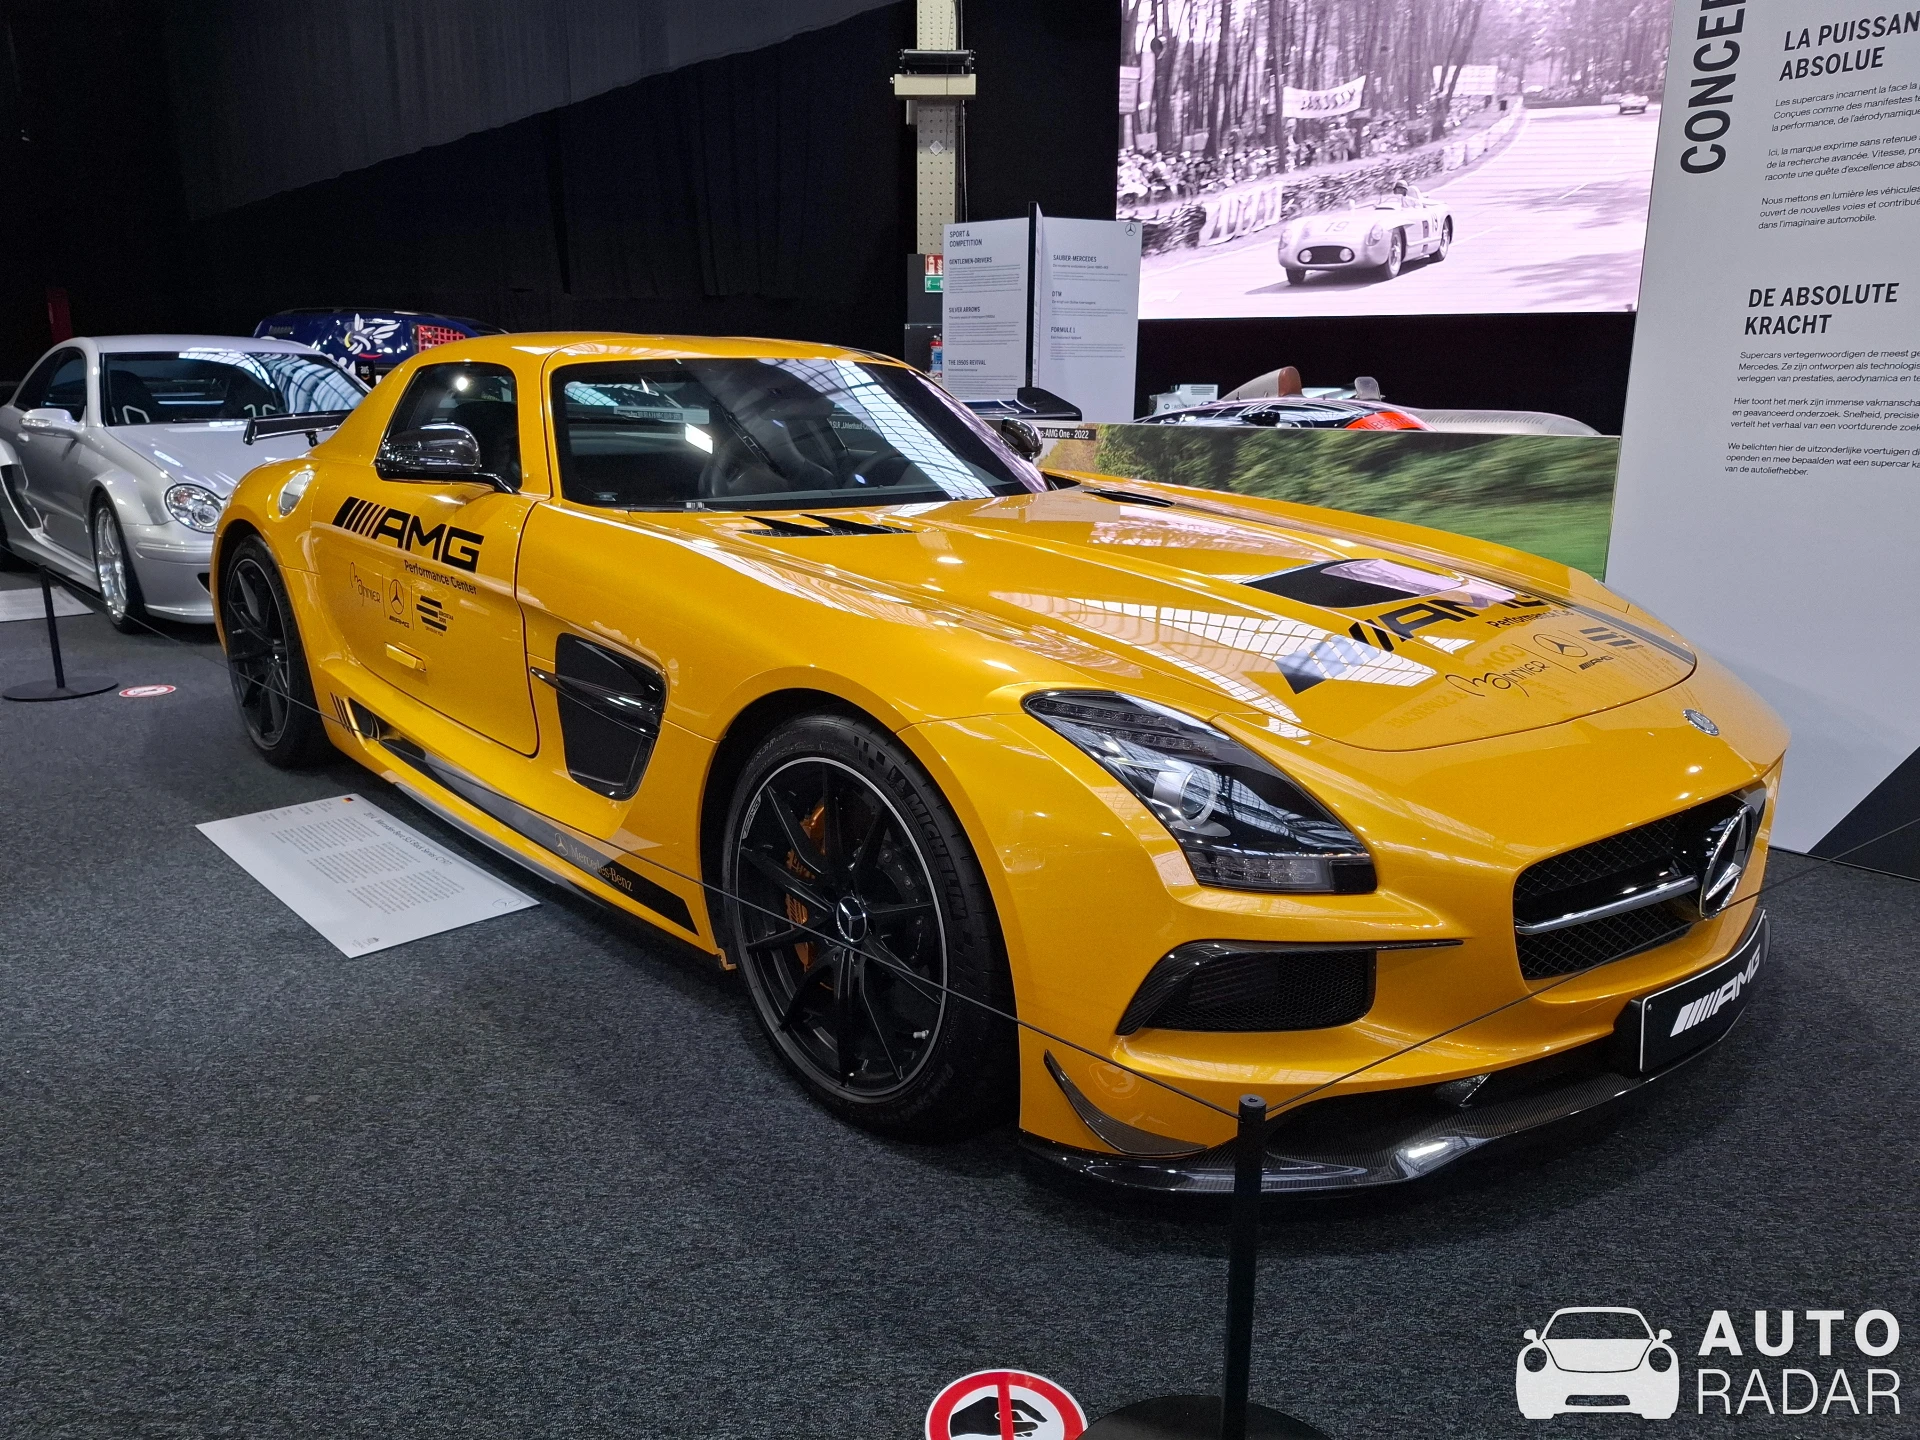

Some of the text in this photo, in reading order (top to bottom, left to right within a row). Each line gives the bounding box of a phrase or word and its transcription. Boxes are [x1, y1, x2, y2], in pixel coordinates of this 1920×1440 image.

[1784, 10, 1920, 51] LA PUISSAN
[1779, 47, 1885, 81] ABSOLUE
[1792, 94, 1833, 105] supercars
[1836, 87, 1876, 99] incarnent
[1888, 84, 1907, 92] face
[1774, 109, 1810, 119] Conçues
[1813, 106, 1844, 114] comme
[1846, 102, 1862, 110] des
[1864, 97, 1912, 108] manifestes
[1780, 119, 1835, 132] performance,
[1838, 116, 1849, 124] de
[1790, 145, 1821, 155] marque
[1823, 141, 1858, 151] exprime
[1860, 139, 1880, 147] sans
[1883, 135, 1917, 144] retenue
[1787, 156, 1829, 166] recherche
[1832, 153, 1869, 162] avancée.
[1872, 149, 1906, 158] Vitesse,
[1765, 171, 1796, 181] raconte
[1815, 167, 1839, 176] quête
[1785, 194, 1818, 203] mettons
[1833, 190, 1864, 199] lumière
[1801, 204, 1840, 214] nouvelles
[1843, 202, 1865, 210] voies
[1827, 214, 1876, 224] automobile.
[1325, 222, 1350, 232] 19
[1748, 283, 1899, 308] DE ABSOLUTE
[1744, 314, 1832, 335] KRACHT
[1784, 351, 1865, 359] vertegenwoordigen
[1794, 363, 1807, 371] zijn
[1837, 375, 1898, 383] aerodynamica
[1810, 399, 1823, 407] zijn
[1884, 411, 1919, 420] precisie
[1059, 430, 1070, 438] One
[1074, 430, 1089, 439] 2022
[1808, 446, 1861, 454] uitzonderlijke
[1864, 448, 1909, 456] voertuigen
[1792, 456, 1834, 465] bepaalden
[1751, 467, 1808, 476] autoliefhebber.
[371, 507, 484, 573] AMG
[404, 559, 477, 595] Performance Center
[906, 793, 969, 921] MICHELIN
[570, 845, 633, 892] Mercedes-Benz
